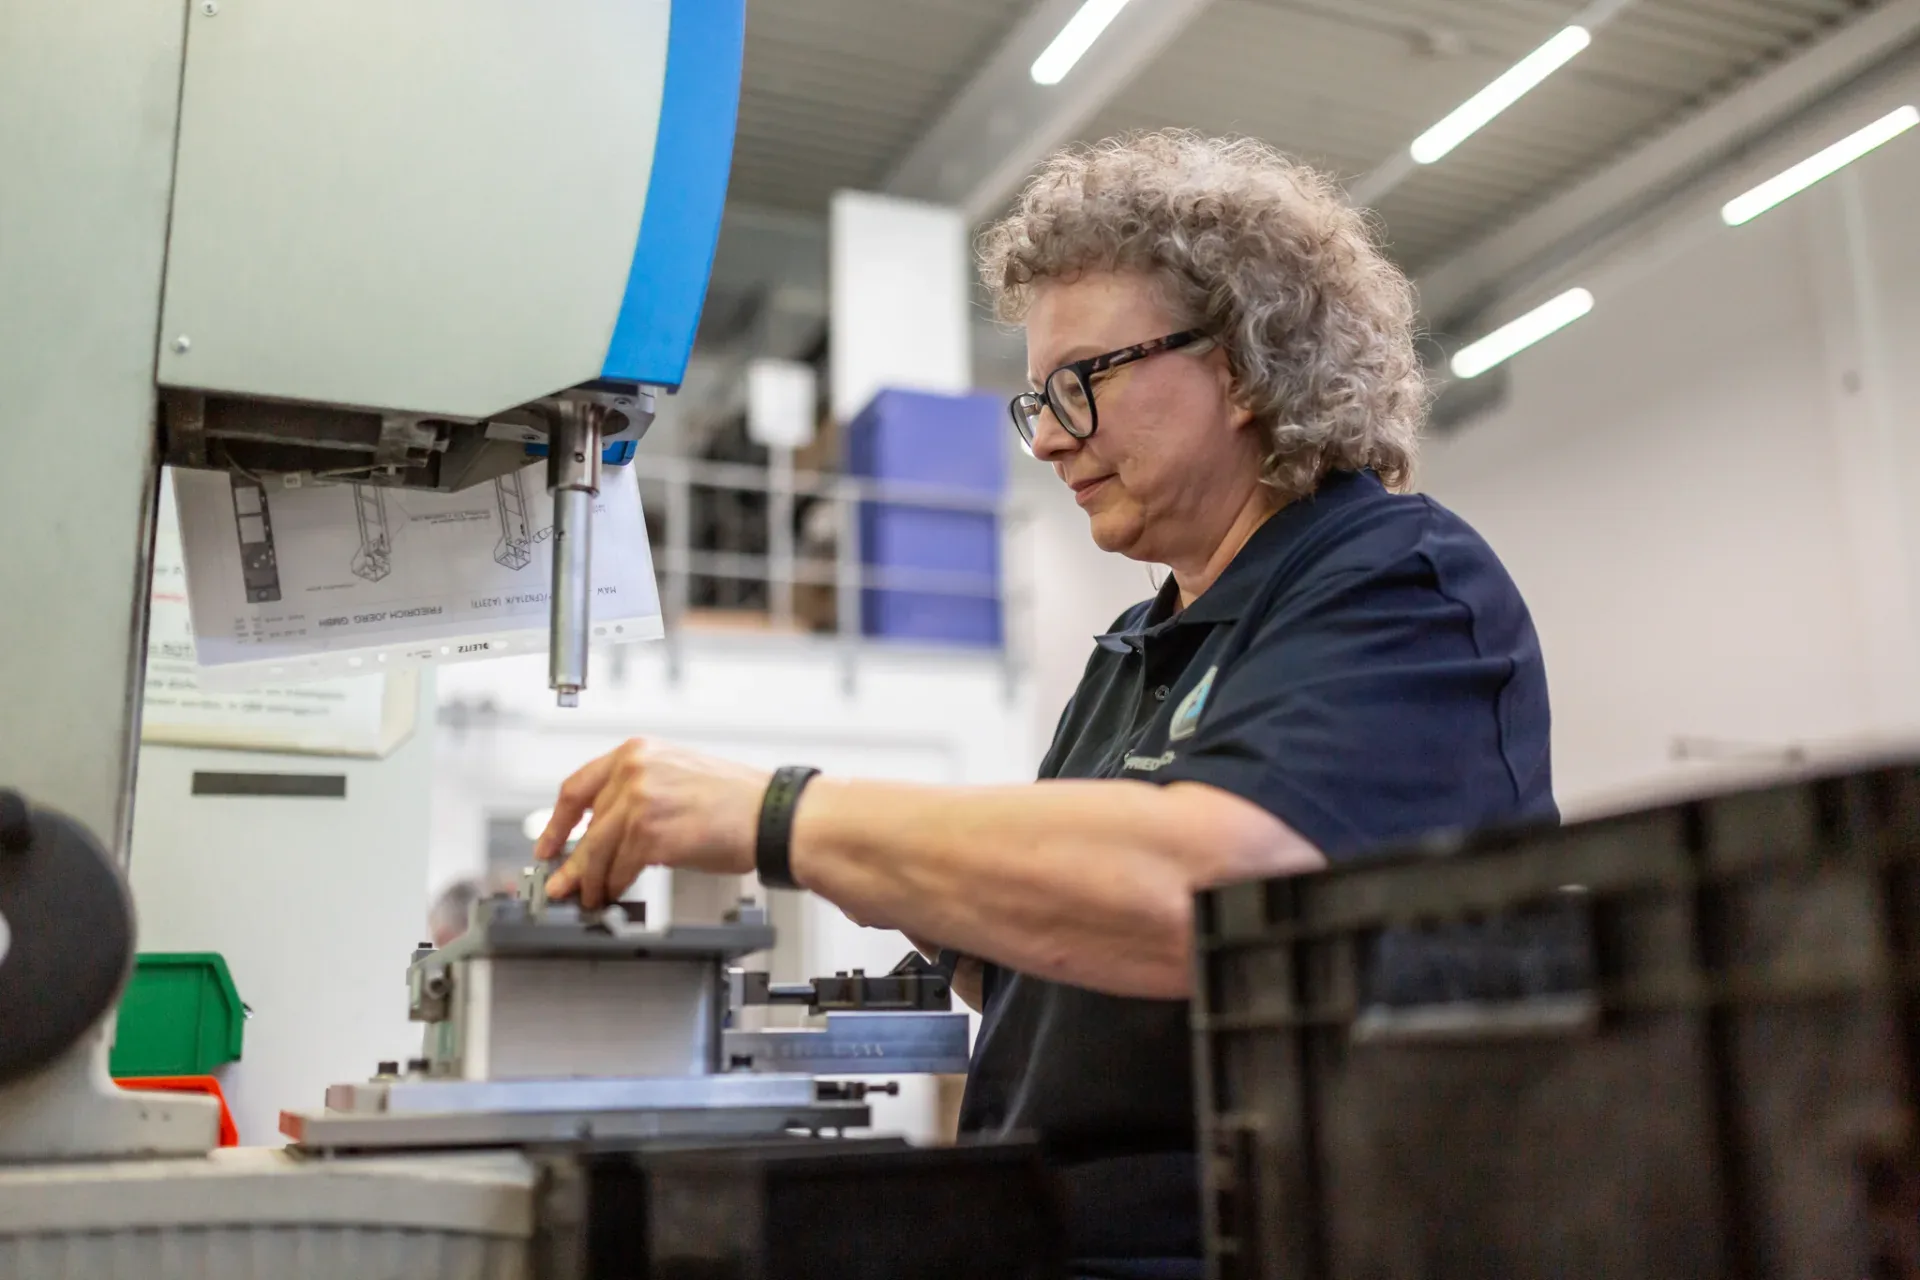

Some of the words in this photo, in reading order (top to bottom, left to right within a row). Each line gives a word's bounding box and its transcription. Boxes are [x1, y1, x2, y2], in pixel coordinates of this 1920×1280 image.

[597, 585, 616, 595] MAW
[353, 611, 387, 625] JOERG
[390, 605, 443, 620] FRIEDRICH
[318, 616, 350, 628] GMBH
[457, 643, 483, 653] LEITZ
